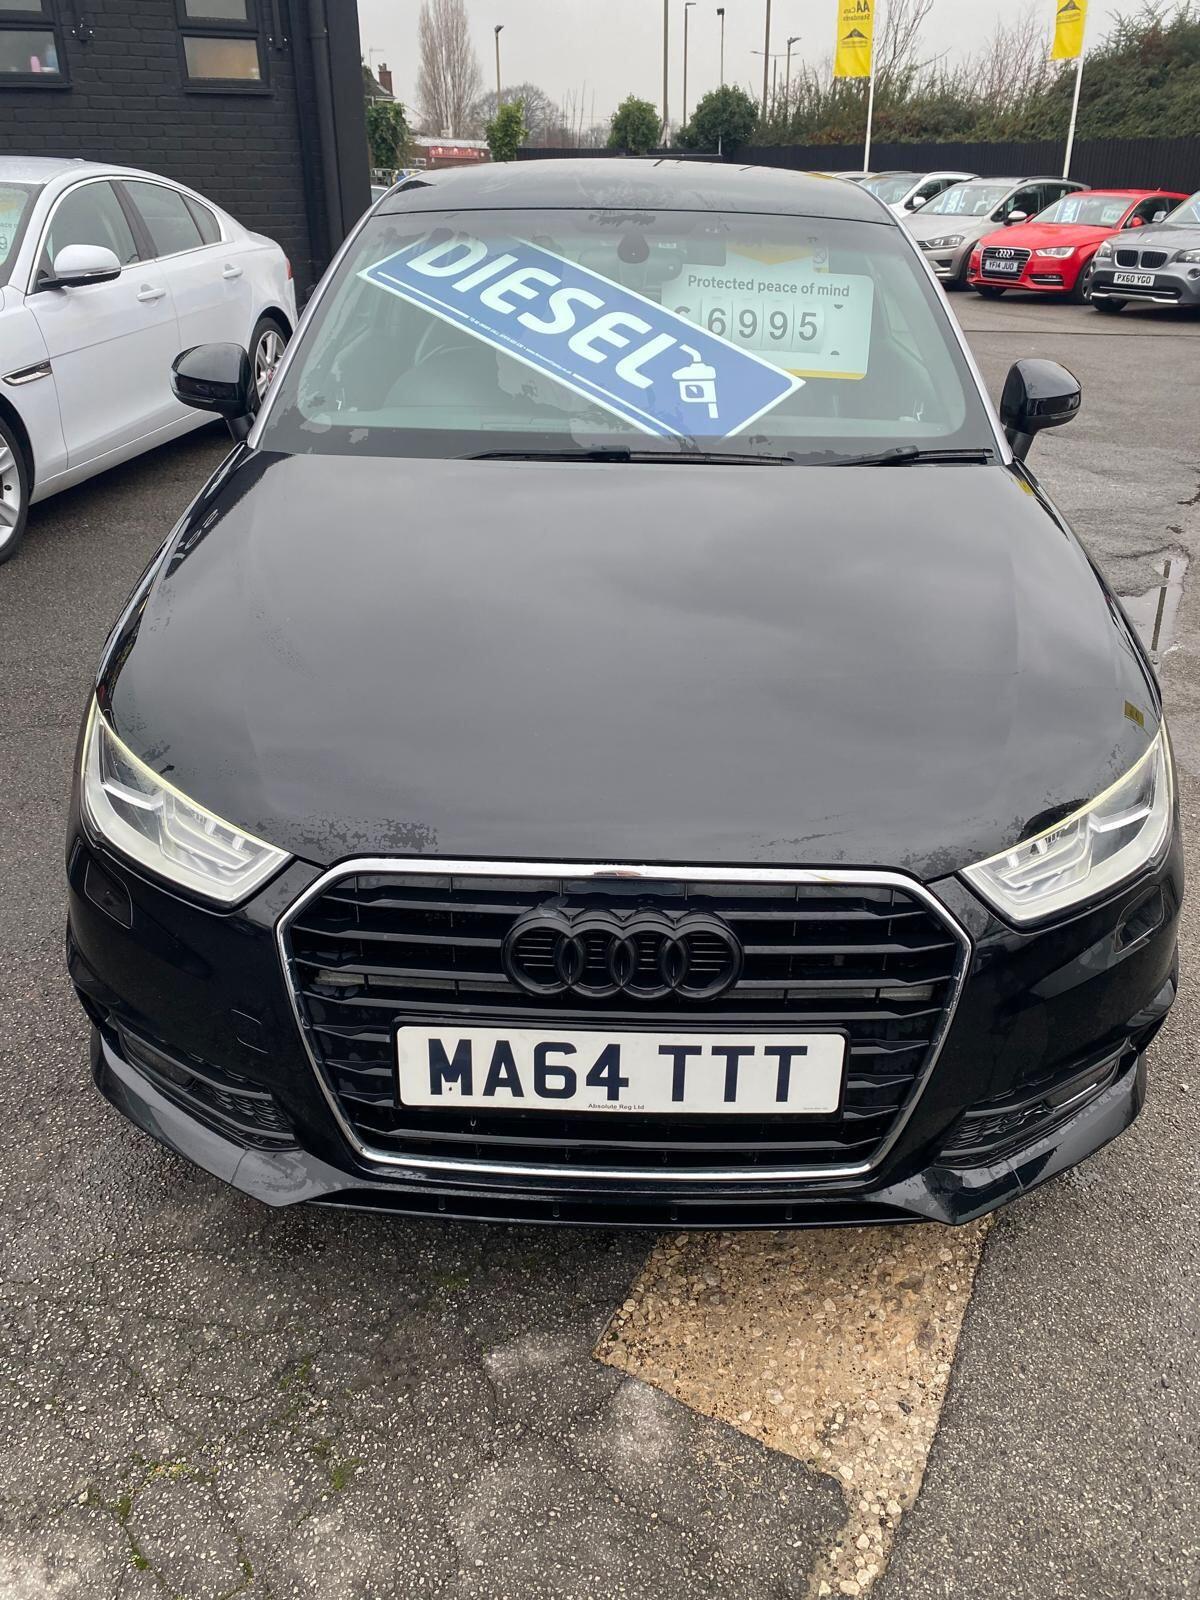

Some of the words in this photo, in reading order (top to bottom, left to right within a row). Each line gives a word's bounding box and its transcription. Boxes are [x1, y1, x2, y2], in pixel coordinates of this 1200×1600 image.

[688, 275, 754, 292] Protected
[758, 281, 797, 294] peace
[801, 283, 815, 294] of
[818, 284, 849, 297] mind
[1117, 274, 1135, 283] PX60
[1137, 275, 1151, 284] YGO
[405, 233, 678, 389] DIESEL
[427, 1037, 630, 1101] MA64
[658, 1044, 808, 1103] TTT
